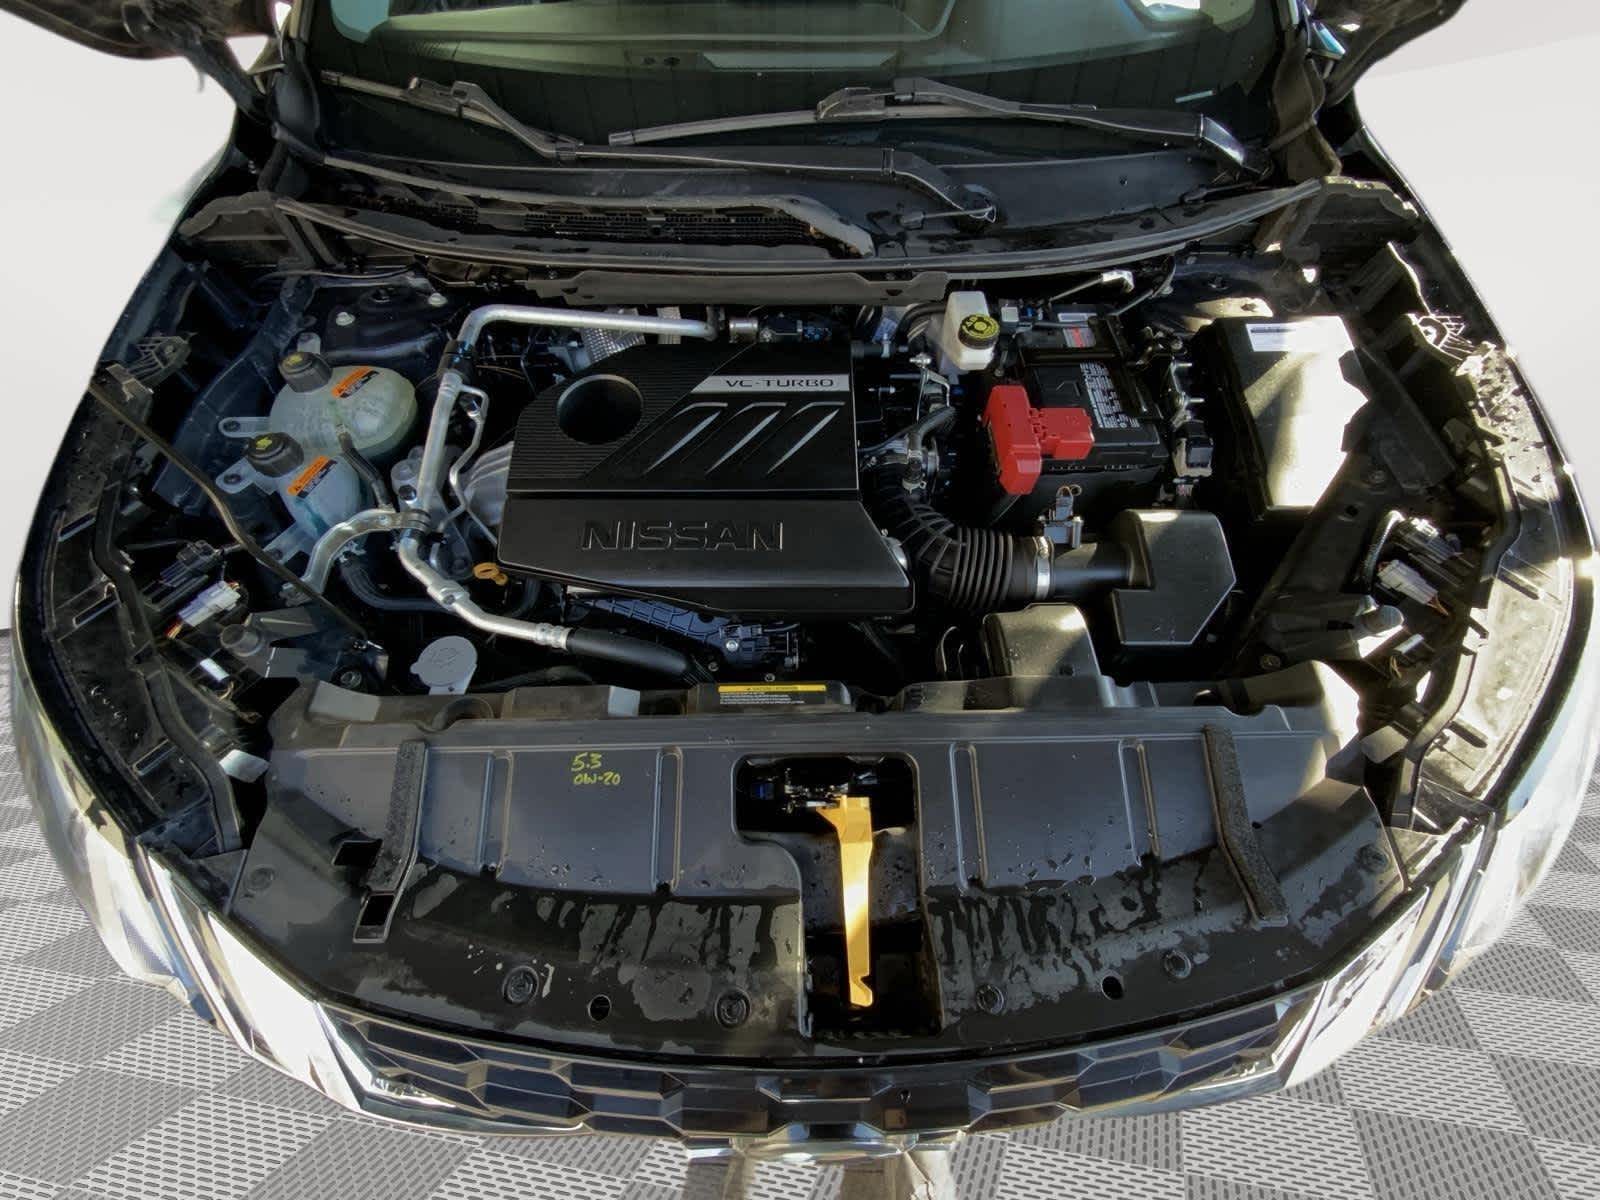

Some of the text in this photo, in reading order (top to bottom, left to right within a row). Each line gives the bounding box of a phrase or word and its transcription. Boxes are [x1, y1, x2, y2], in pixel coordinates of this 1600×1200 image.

[726, 378, 833, 389] VC-TURBO
[581, 521, 783, 551] NISSAN
[571, 751, 602, 772] 5.3
